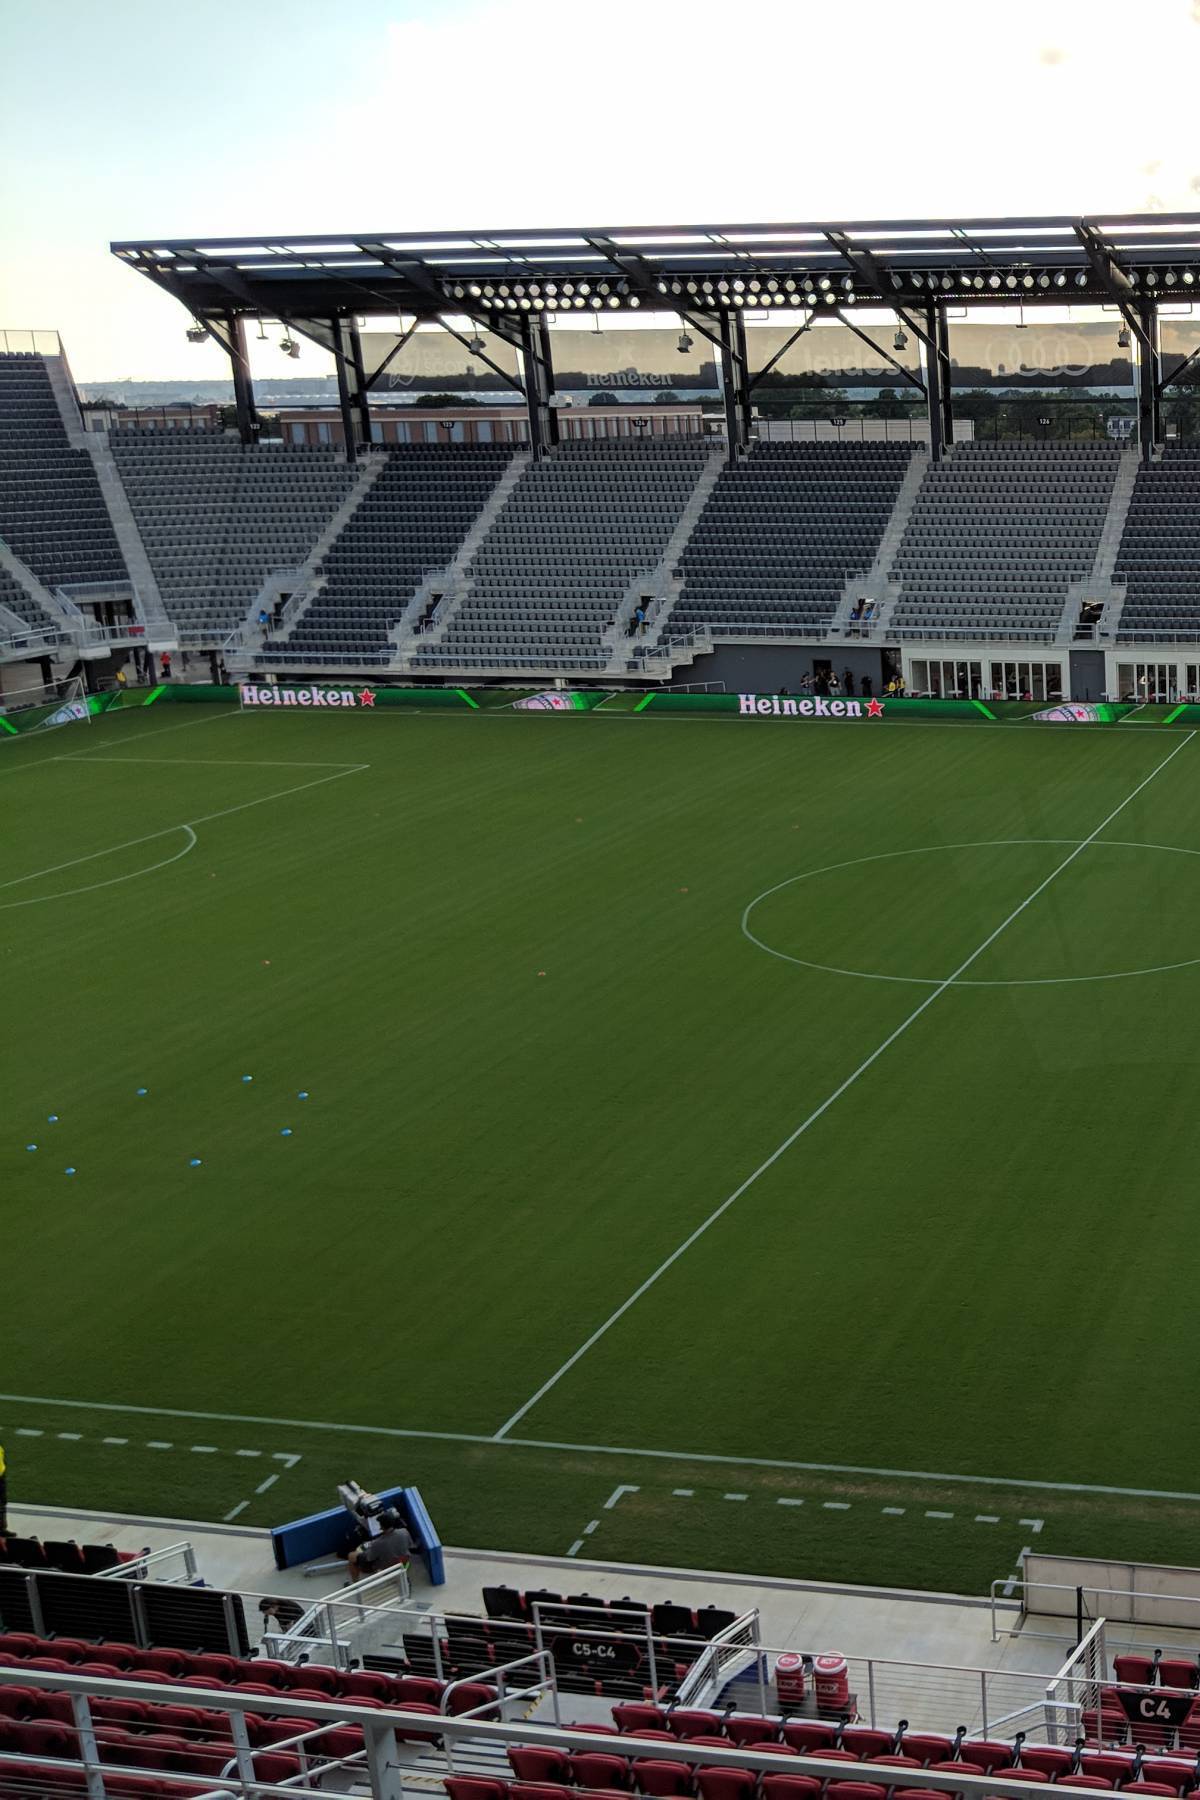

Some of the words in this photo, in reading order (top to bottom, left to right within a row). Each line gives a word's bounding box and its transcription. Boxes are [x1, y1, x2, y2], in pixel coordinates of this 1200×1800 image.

[586, 370, 673, 386] Heineken
[242, 685, 357, 707] Heineken
[738, 693, 862, 717] Heineken
[572, 1643, 616, 1658] C5-C4
[1139, 1698, 1171, 1719] C4
